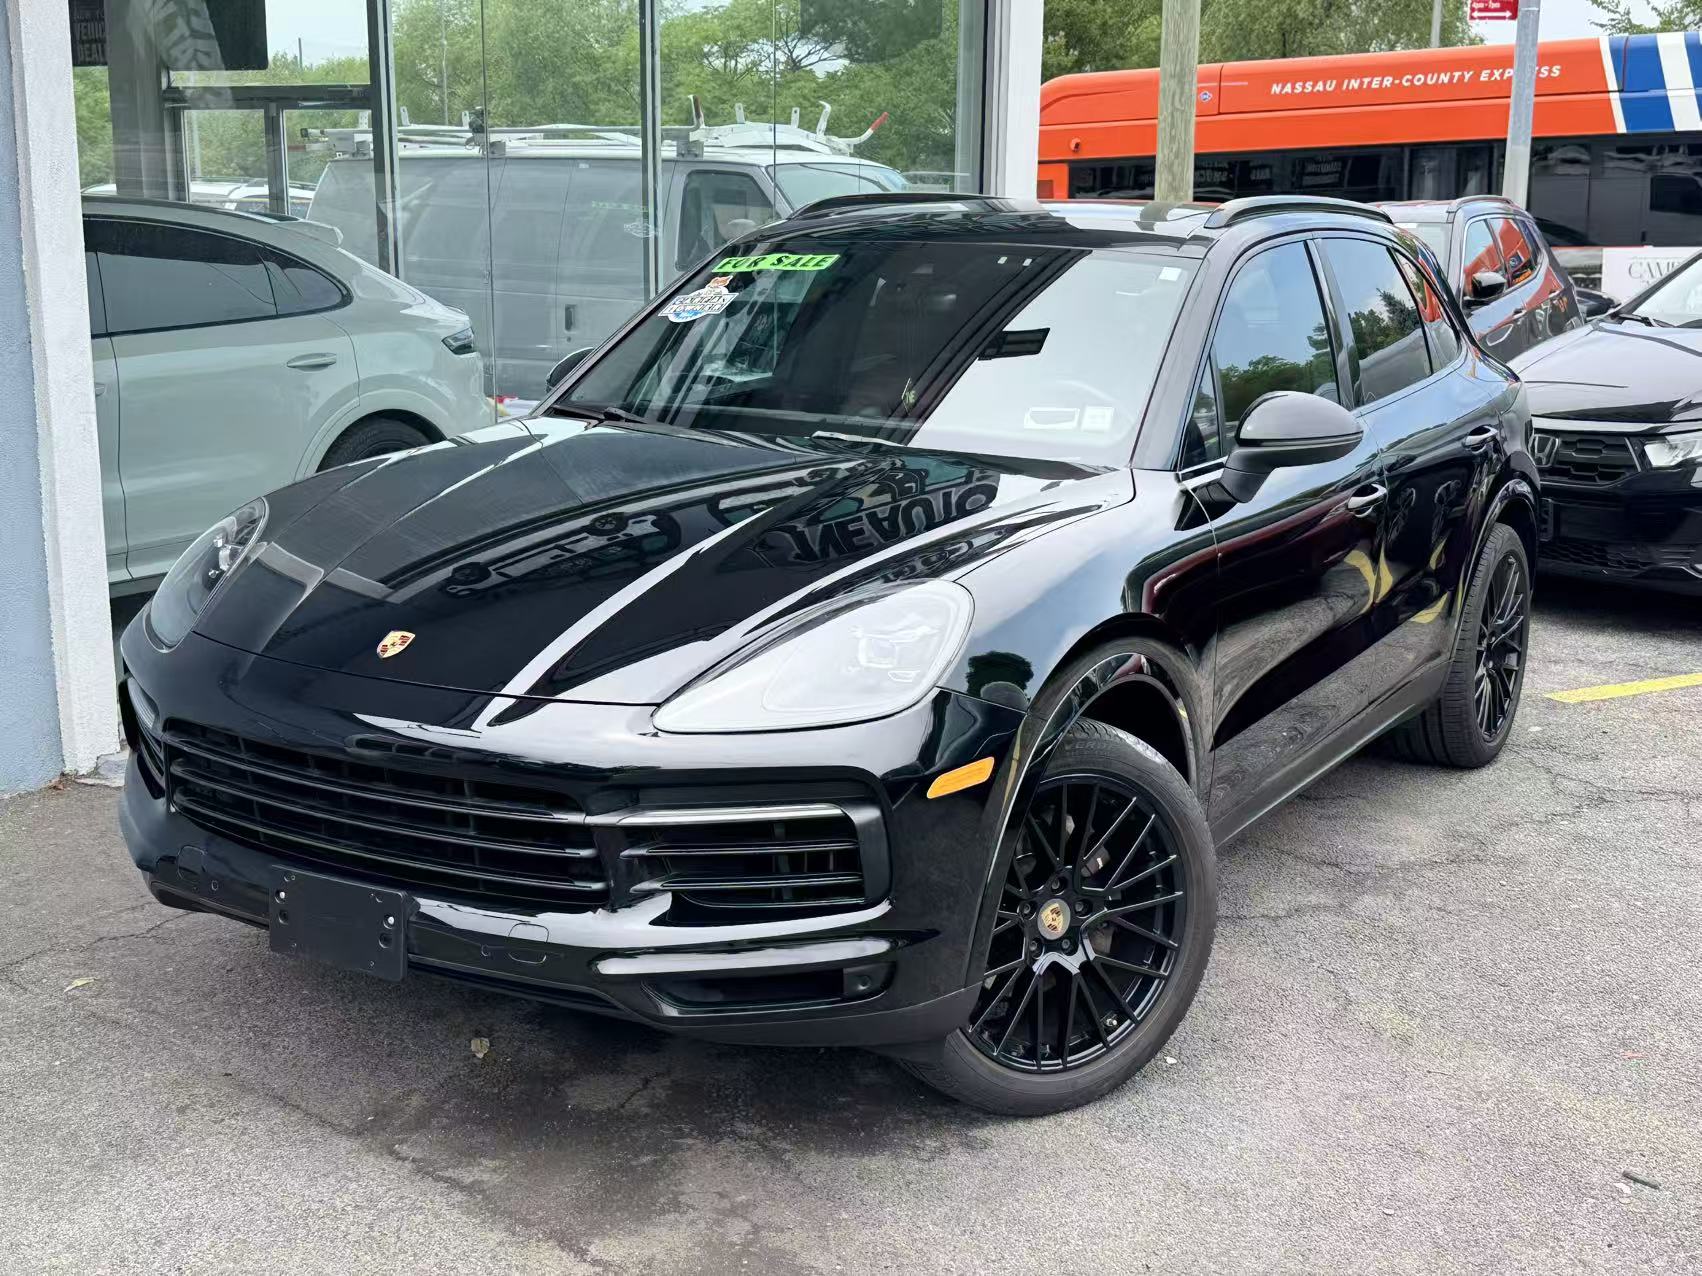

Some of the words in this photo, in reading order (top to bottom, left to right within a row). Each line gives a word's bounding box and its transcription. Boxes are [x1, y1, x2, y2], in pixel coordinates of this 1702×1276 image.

[1270, 80, 1336, 95] NASSAU
[1342, 71, 1473, 91] INTER-COUNTY
[1479, 65, 1562, 82] EXPSS
[717, 257, 766, 270] FOR
[769, 255, 834, 268] SALE
